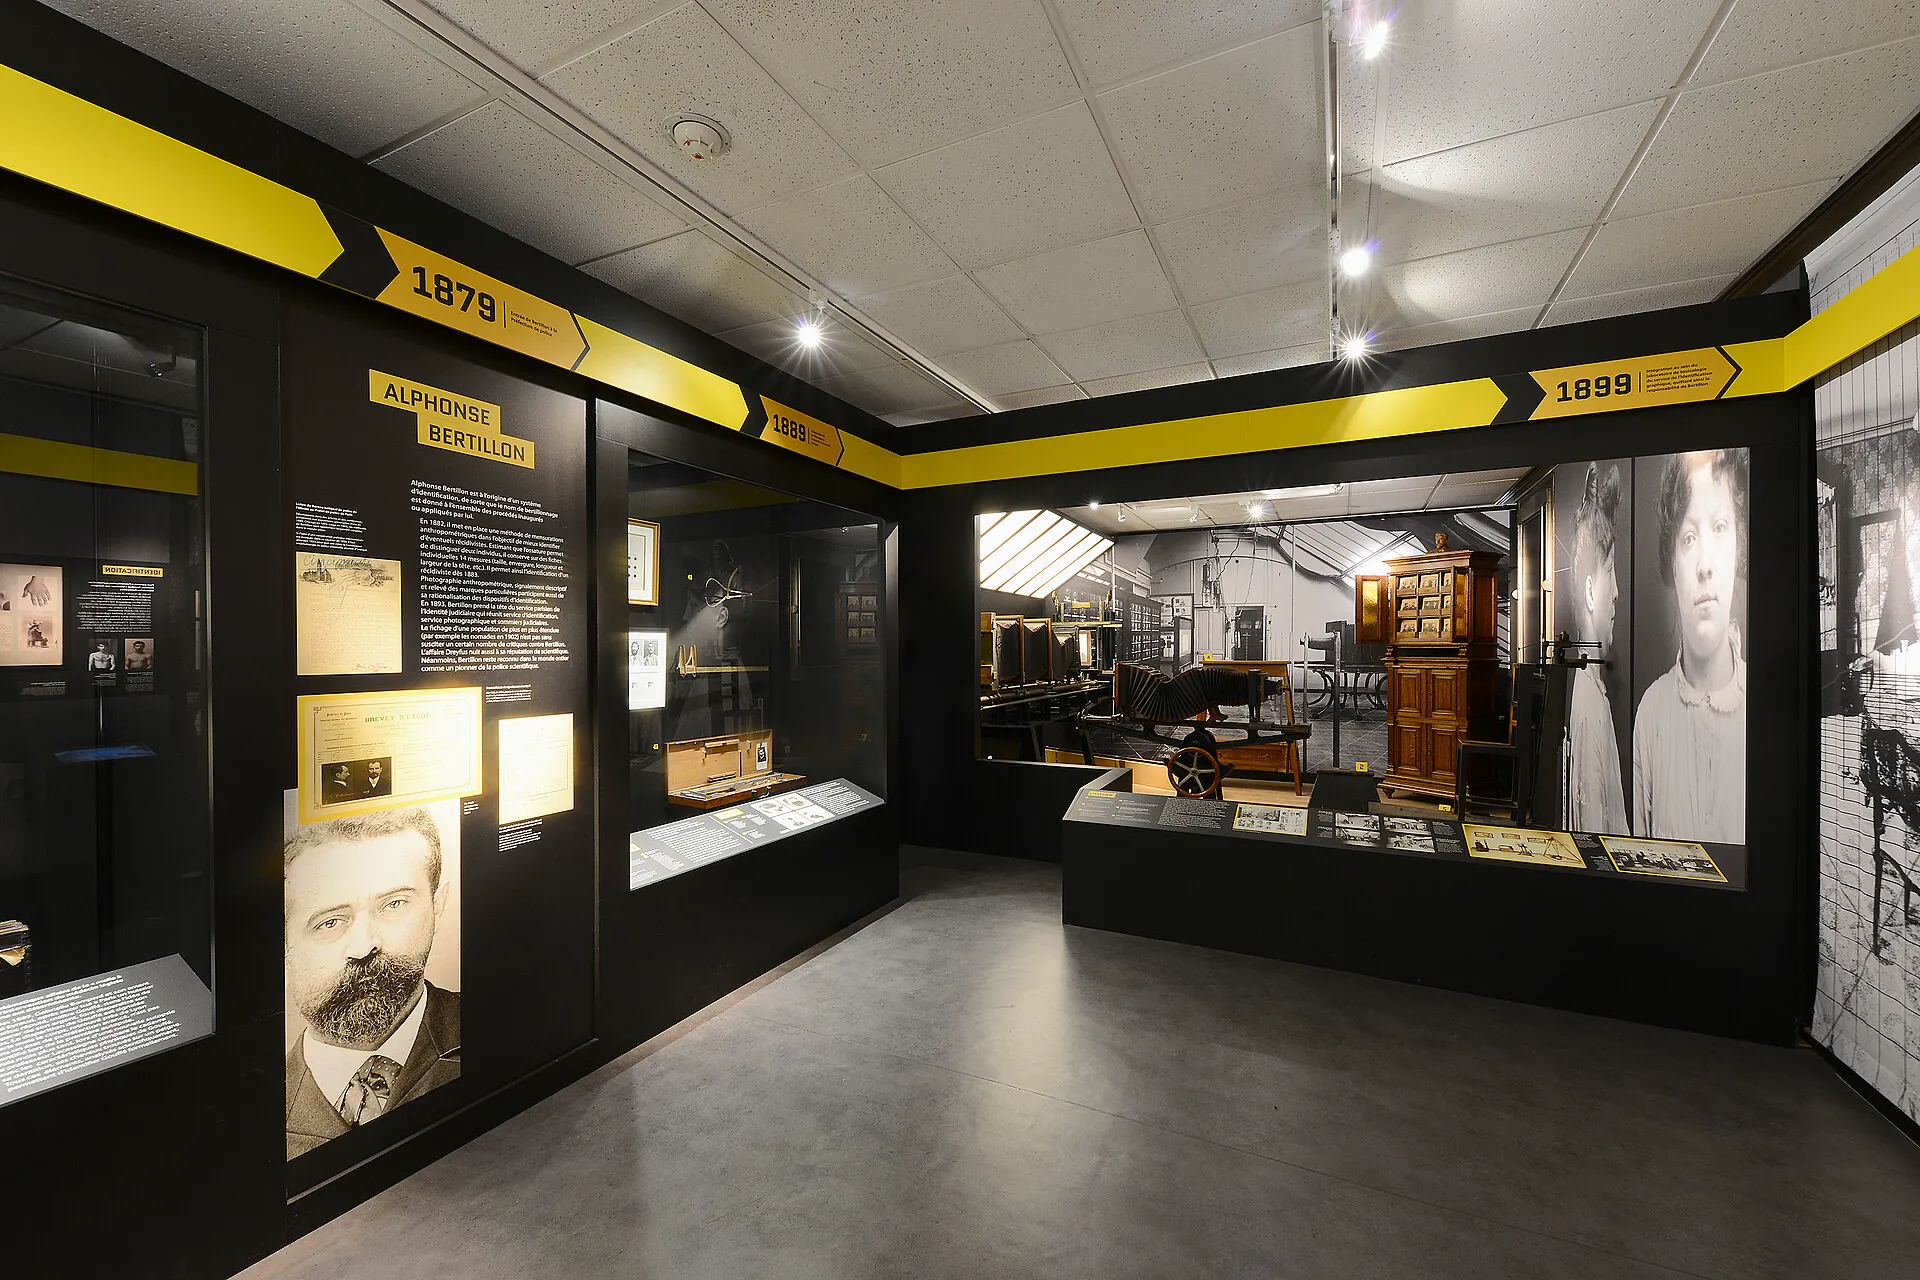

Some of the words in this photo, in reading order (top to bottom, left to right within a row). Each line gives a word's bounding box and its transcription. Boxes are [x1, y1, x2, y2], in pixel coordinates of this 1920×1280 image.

[413, 266, 495, 322] 1879
[1556, 372, 1632, 402] 1899
[384, 383, 490, 426] ALPHONSE
[773, 414, 805, 442] 1889
[429, 424, 525, 462] BERTILLON
[411, 479, 441, 490] Alphonse
[443, 484, 468, 495] Bertillon
[421, 507, 452, 516] appliqués
[422, 497, 443, 506] donné
[493, 510, 517, 518] procédés
[420, 526, 477, 539] anthropométriques
[478, 533, 491, 541] dans
[473, 525, 488, 533] place
[500, 529, 523, 538] méthode
[430, 543, 460, 553] distinguer
[489, 542, 511, 551] Estimant
[420, 550, 458, 560] individuelles
[420, 559, 442, 568] largeur
[421, 567, 451, 575] récidiviste
[421, 575, 461, 585] Photographie
[429, 592, 470, 600] rationalisation
[448, 608, 475, 617] judiciaire
[444, 617, 490, 626] photographique
[430, 624, 452, 633] fichage
[470, 625, 500, 633] population
[421, 632, 434, 641] (par
[435, 633, 460, 641] exemple
[446, 648, 468, 656] Dreyfus
[365, 715, 395, 723] BREVET
